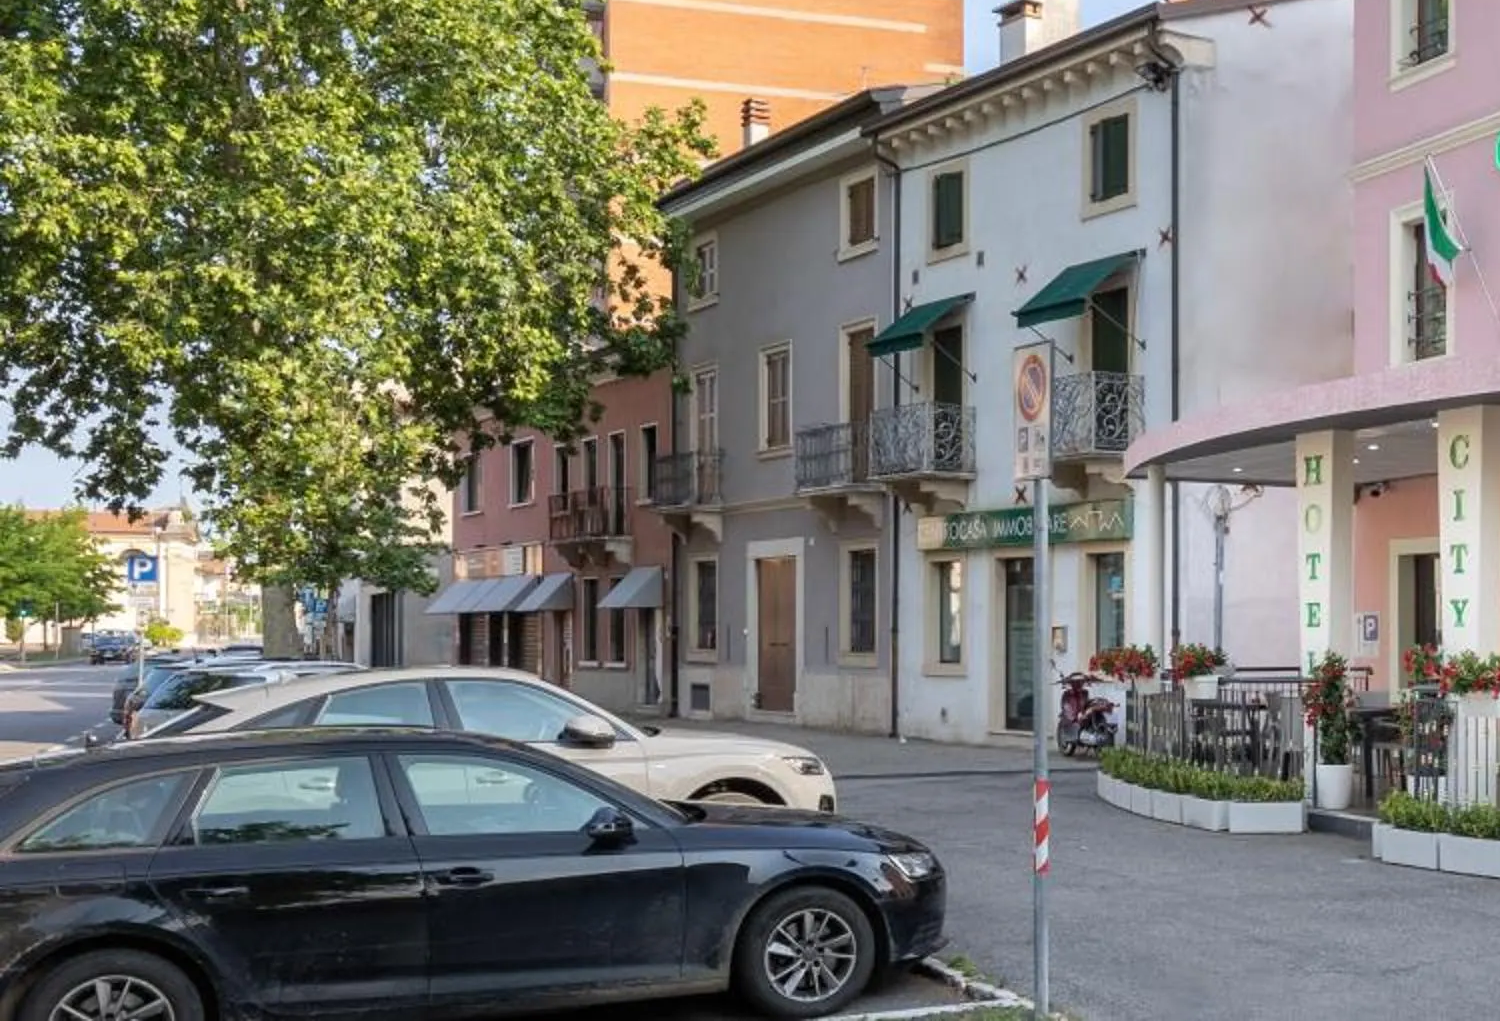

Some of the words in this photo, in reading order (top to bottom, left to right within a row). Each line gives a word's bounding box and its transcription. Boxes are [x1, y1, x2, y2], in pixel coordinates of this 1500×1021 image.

[1449, 433, 1469, 628] CITY
[133, 558, 153, 580] P
[1366, 618, 1377, 638] P
